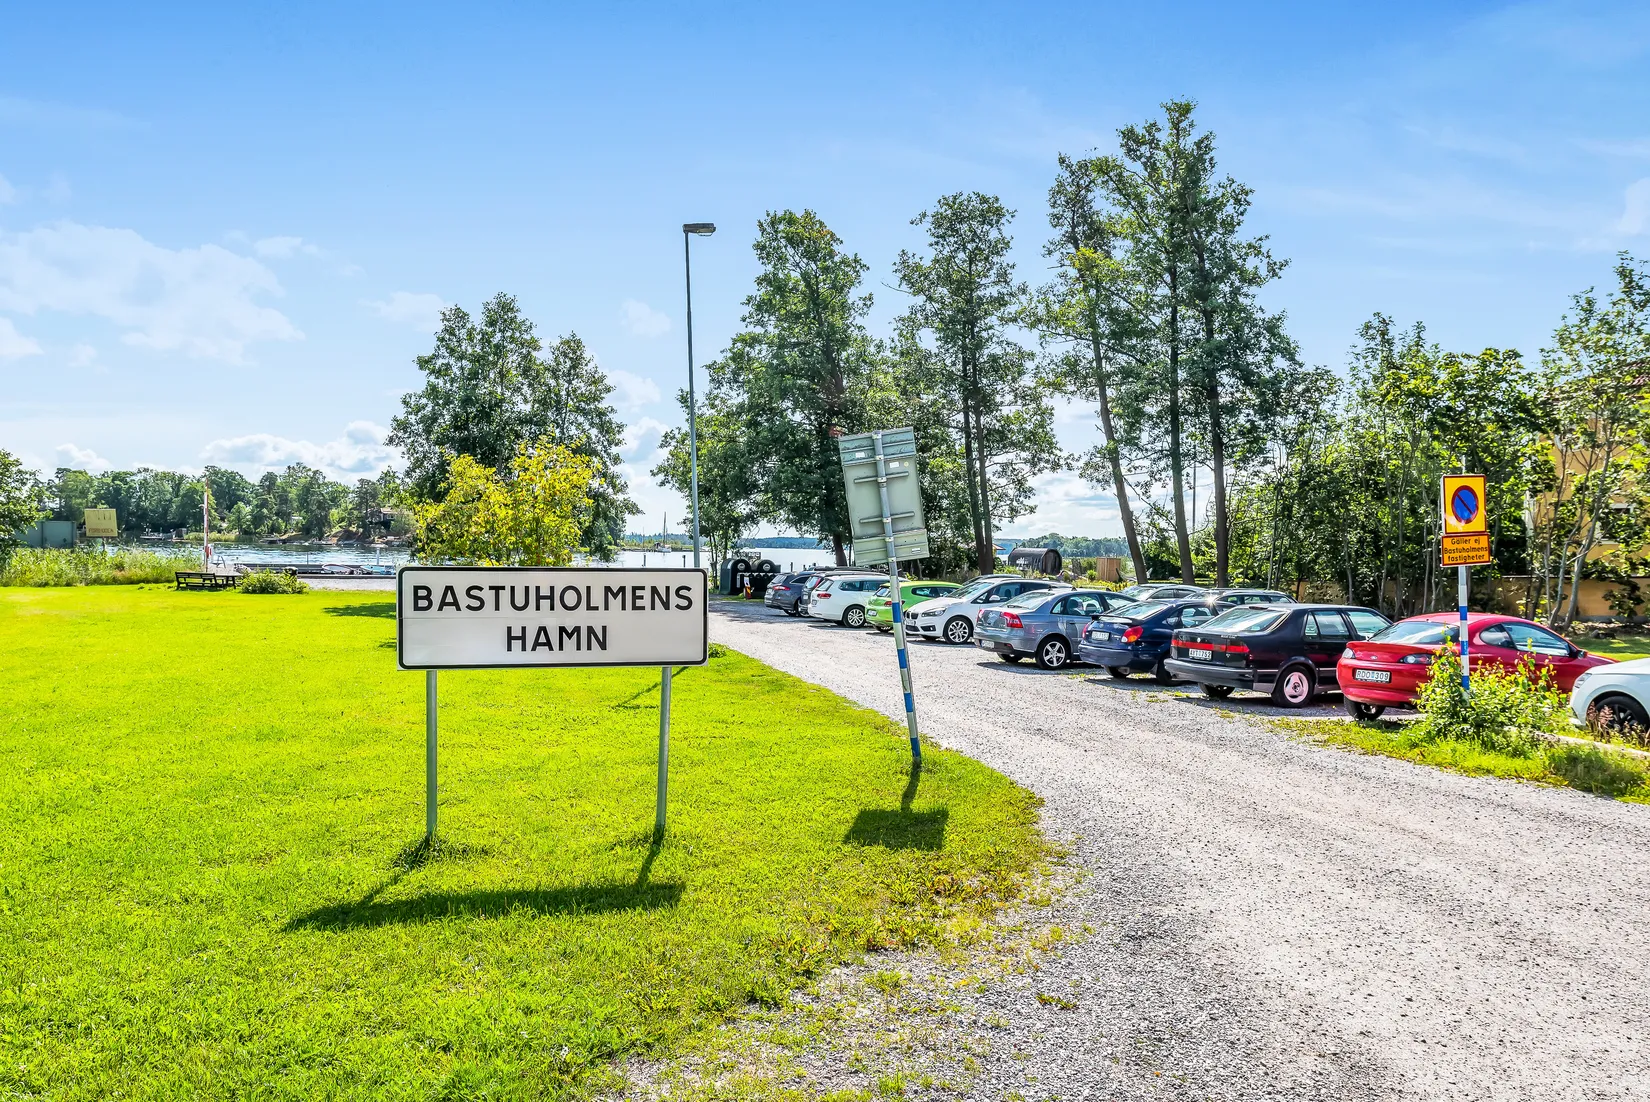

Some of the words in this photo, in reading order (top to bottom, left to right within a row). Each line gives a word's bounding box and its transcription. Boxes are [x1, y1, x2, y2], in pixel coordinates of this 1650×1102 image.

[1474, 537, 1480, 545] ej
[1444, 545, 1488, 555] Bastuholmens
[1448, 553, 1485, 562] fastigheter
[412, 585, 693, 612] BASTUHOLMENS
[506, 625, 608, 652] HAMN
